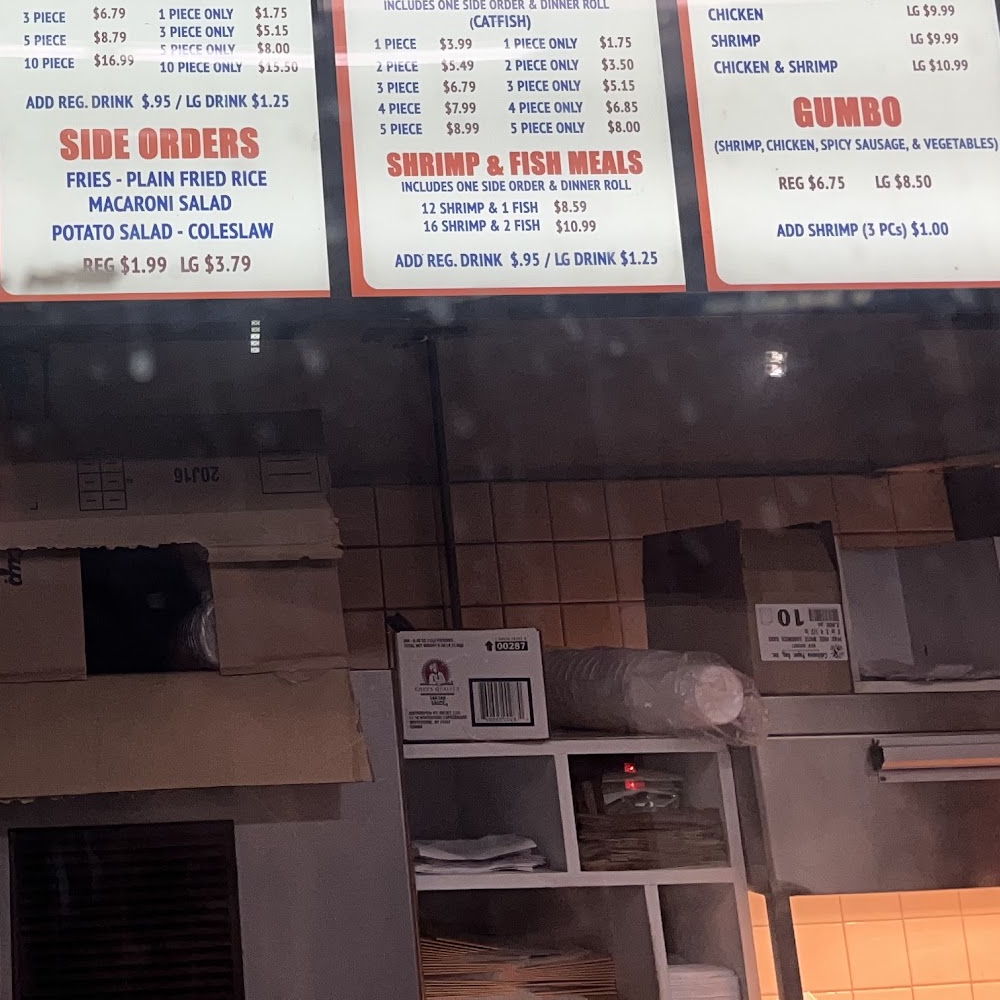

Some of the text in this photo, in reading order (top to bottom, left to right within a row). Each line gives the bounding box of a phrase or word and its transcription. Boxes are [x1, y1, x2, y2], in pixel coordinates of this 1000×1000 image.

[470, 15, 531, 31] (CATFISH)
[793, 96, 902, 128] GUMBO
[59, 127, 259, 161] SIDE ORDERS
[714, 137, 998, 155] (SHRIMP, CHICKEN, SPICY SAUSAGE, & VEGETABLES)
[386, 150, 643, 177] SHRIMP & FISH MEALS
[778, 175, 845, 191] REG $6.75
[875, 173, 932, 190] LG $8.50
[89, 195, 232, 212] MACARONI SALAD
[422, 201, 538, 214] 12 SHRIMP & 1 FISH
[554, 199, 587, 214] $8.59
[52, 224, 115, 241] POTATO
[120, 223, 173, 240] SALAD
[188, 222, 274, 240] COLESLAW
[777, 221, 949, 240] ADD SHRIMP (3 PCs) $1.00
[120, 256, 167, 274] $1.99
[180, 254, 251, 274] LG $3.79
[777, 609, 805, 627] 10
[496, 641, 527, 651] 00287
